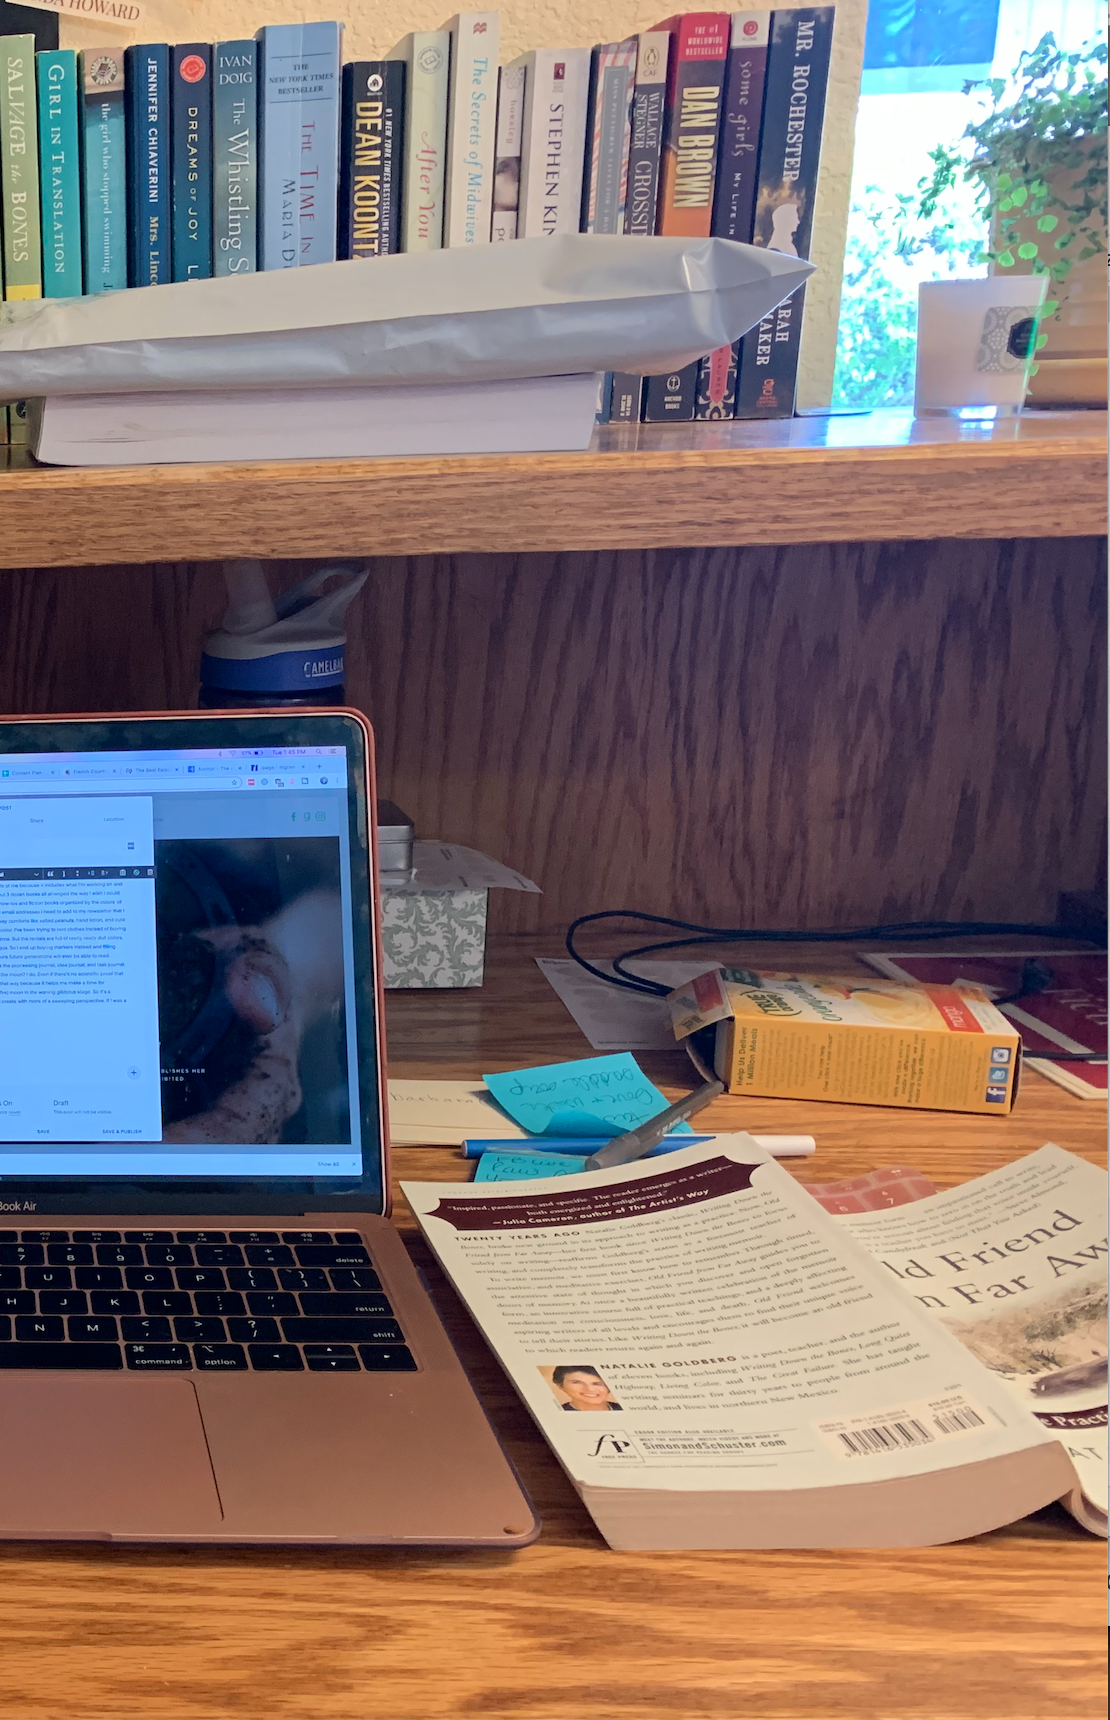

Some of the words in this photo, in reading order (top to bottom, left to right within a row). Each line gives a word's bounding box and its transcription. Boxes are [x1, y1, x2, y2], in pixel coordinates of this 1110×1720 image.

[69, 0, 141, 21] HOWARD
[688, 36, 724, 45] WORLDWIDE
[695, 25, 706, 33] THE
[795, 20, 815, 57] MR.
[219, 55, 252, 68] IVAN
[686, 46, 724, 56] BESTSELLER
[219, 72, 253, 85] DOIG
[269, 76, 287, 84] NEW
[287, 75, 308, 83] YORK
[309, 73, 334, 82] TIMES
[292, 63, 310, 72] THE
[472, 57, 489, 85] The
[48, 64, 65, 119] GIRL
[147, 58, 158, 122] JENNIFER
[277, 85, 325, 95] BESTSELLER
[7, 57, 26, 156] SALVAGE
[102, 103, 111, 120] the
[233, 98, 246, 125] The
[470, 92, 487, 146] Secrets
[633, 92, 649, 149] STEGNER
[645, 91, 660, 149] WALLACE
[680, 86, 720, 128] DAN
[782, 64, 810, 181] ROCHESTER
[50, 126, 62, 145] IN
[99, 124, 111, 146] girl
[187, 107, 198, 181] DREAMS
[354, 101, 383, 166] DEAN
[544, 103, 565, 196] STEPHEN
[728, 112, 755, 156] girls
[10, 163, 23, 184] the
[102, 148, 112, 169] who
[148, 129, 159, 203] CHIAVERINI
[416, 131, 438, 195] After
[463, 151, 478, 164] of
[673, 134, 716, 208] BROWN
[100, 172, 112, 214] stopped
[220, 128, 251, 251] Whistling
[300, 165, 319, 224] TIME
[52, 151, 65, 273] TRANSLATION
[282, 179, 296, 240] MARIA
[418, 202, 435, 238] You
[465, 172, 483, 243] Midwives
[11, 191, 29, 262] BONES
[149, 217, 159, 246] Mrs.
[187, 207, 198, 241] JOY
[100, 218, 113, 272] swimming
[739, 1026, 749, 1050] Deliver
[751, 1028, 759, 1052] Meals
[738, 1051, 746, 1061] Us
[747, 1055, 756, 1080] Million
[735, 1062, 745, 1086] Help
[3, 1099, 12, 1107] On
[53, 1099, 69, 1107] Draft
[23, 1201, 37, 1212] Air
[528, 1213, 579, 1225] Cameron,
[579, 1209, 614, 1220] author
[628, 1203, 648, 1212] The
[649, 1196, 685, 1209] Artist's
[686, 1189, 710, 1203] Way
[934, 1208, 1085, 1274] Friend
[949, 1274, 1036, 1306] Far
[599, 1360, 658, 1371] NATALIE
[661, 1355, 738, 1368] GOLDBERG
[642, 1438, 787, 1452] SimonandSchuster.com
